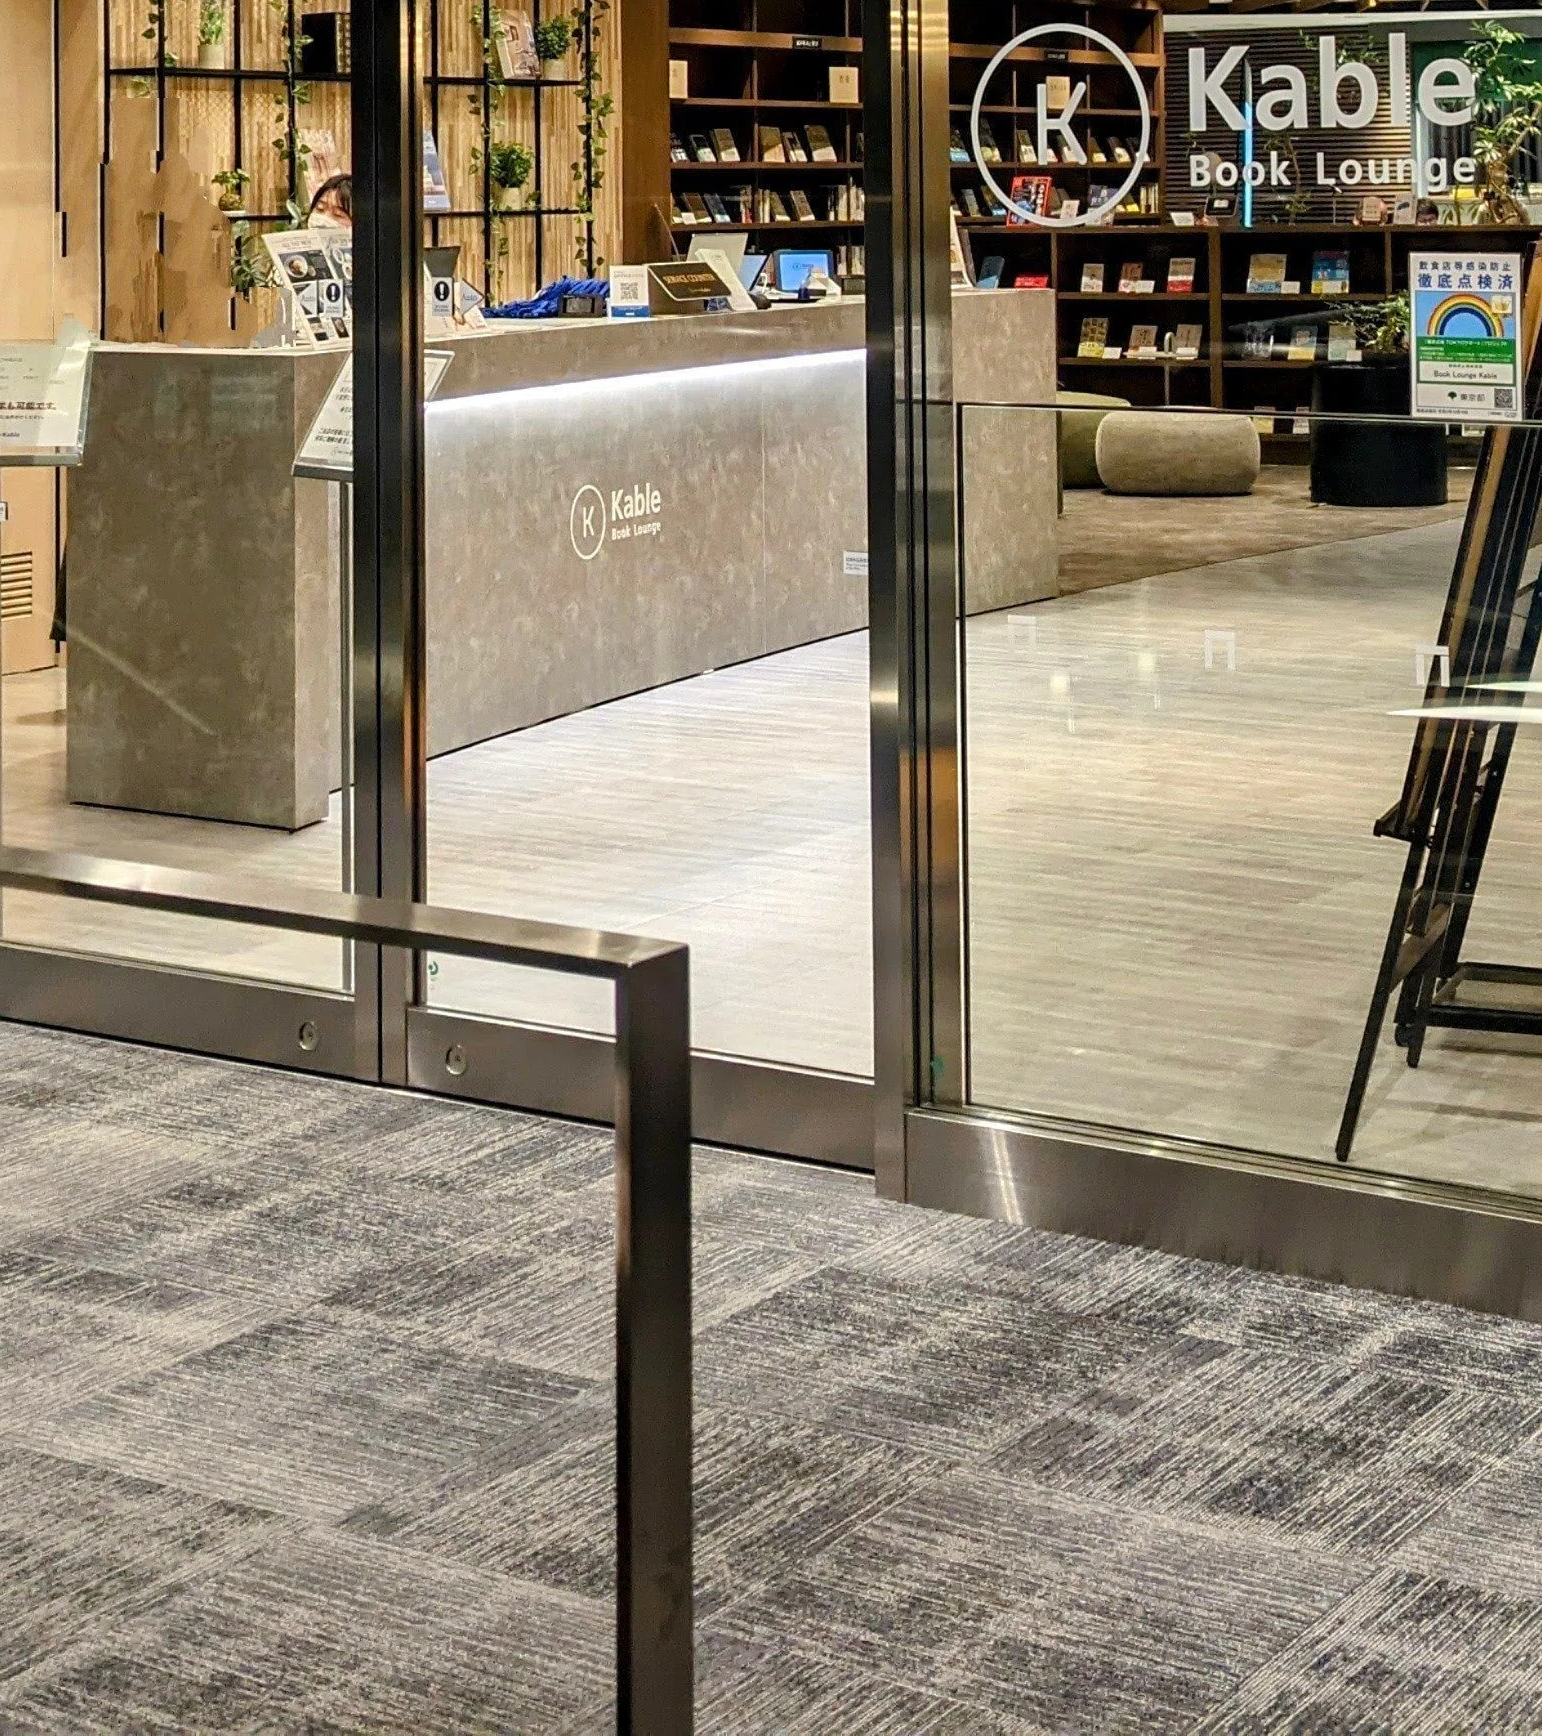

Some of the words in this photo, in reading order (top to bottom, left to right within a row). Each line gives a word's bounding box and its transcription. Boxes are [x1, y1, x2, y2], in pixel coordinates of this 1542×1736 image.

[1188, 32, 1477, 132] Kable
[1189, 151, 1291, 188] Book
[1316, 152, 1476, 193] Lounge
[1418, 273, 1513, 290] 徹底点検済
[611, 482, 661, 521] Kable
